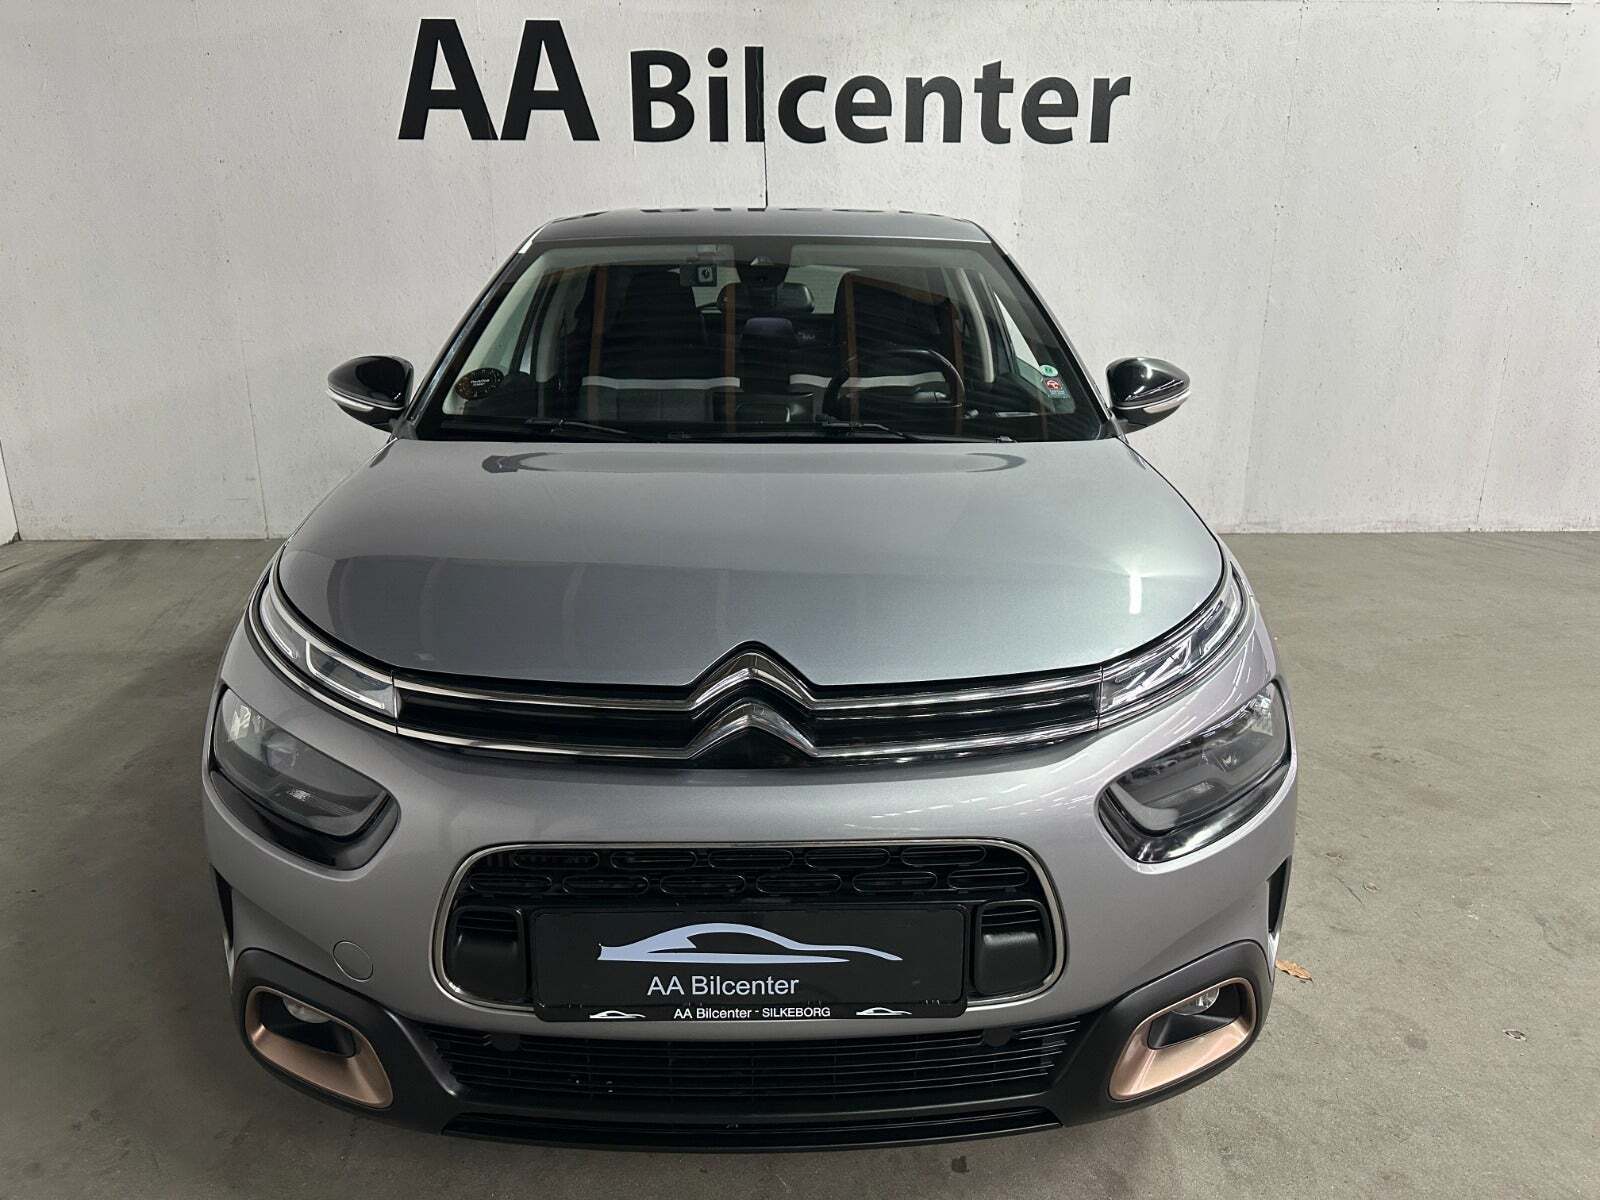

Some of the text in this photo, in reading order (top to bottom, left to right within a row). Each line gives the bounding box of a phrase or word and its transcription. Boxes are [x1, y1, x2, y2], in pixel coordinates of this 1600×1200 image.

[399, 19, 1131, 144] AA Bilcenter
[647, 975, 800, 996] AA Bilcenter
[673, 1008, 693, 1019] AA
[696, 1007, 752, 1019] Bilcenter
[762, 1007, 831, 1018] SILKEBORG
